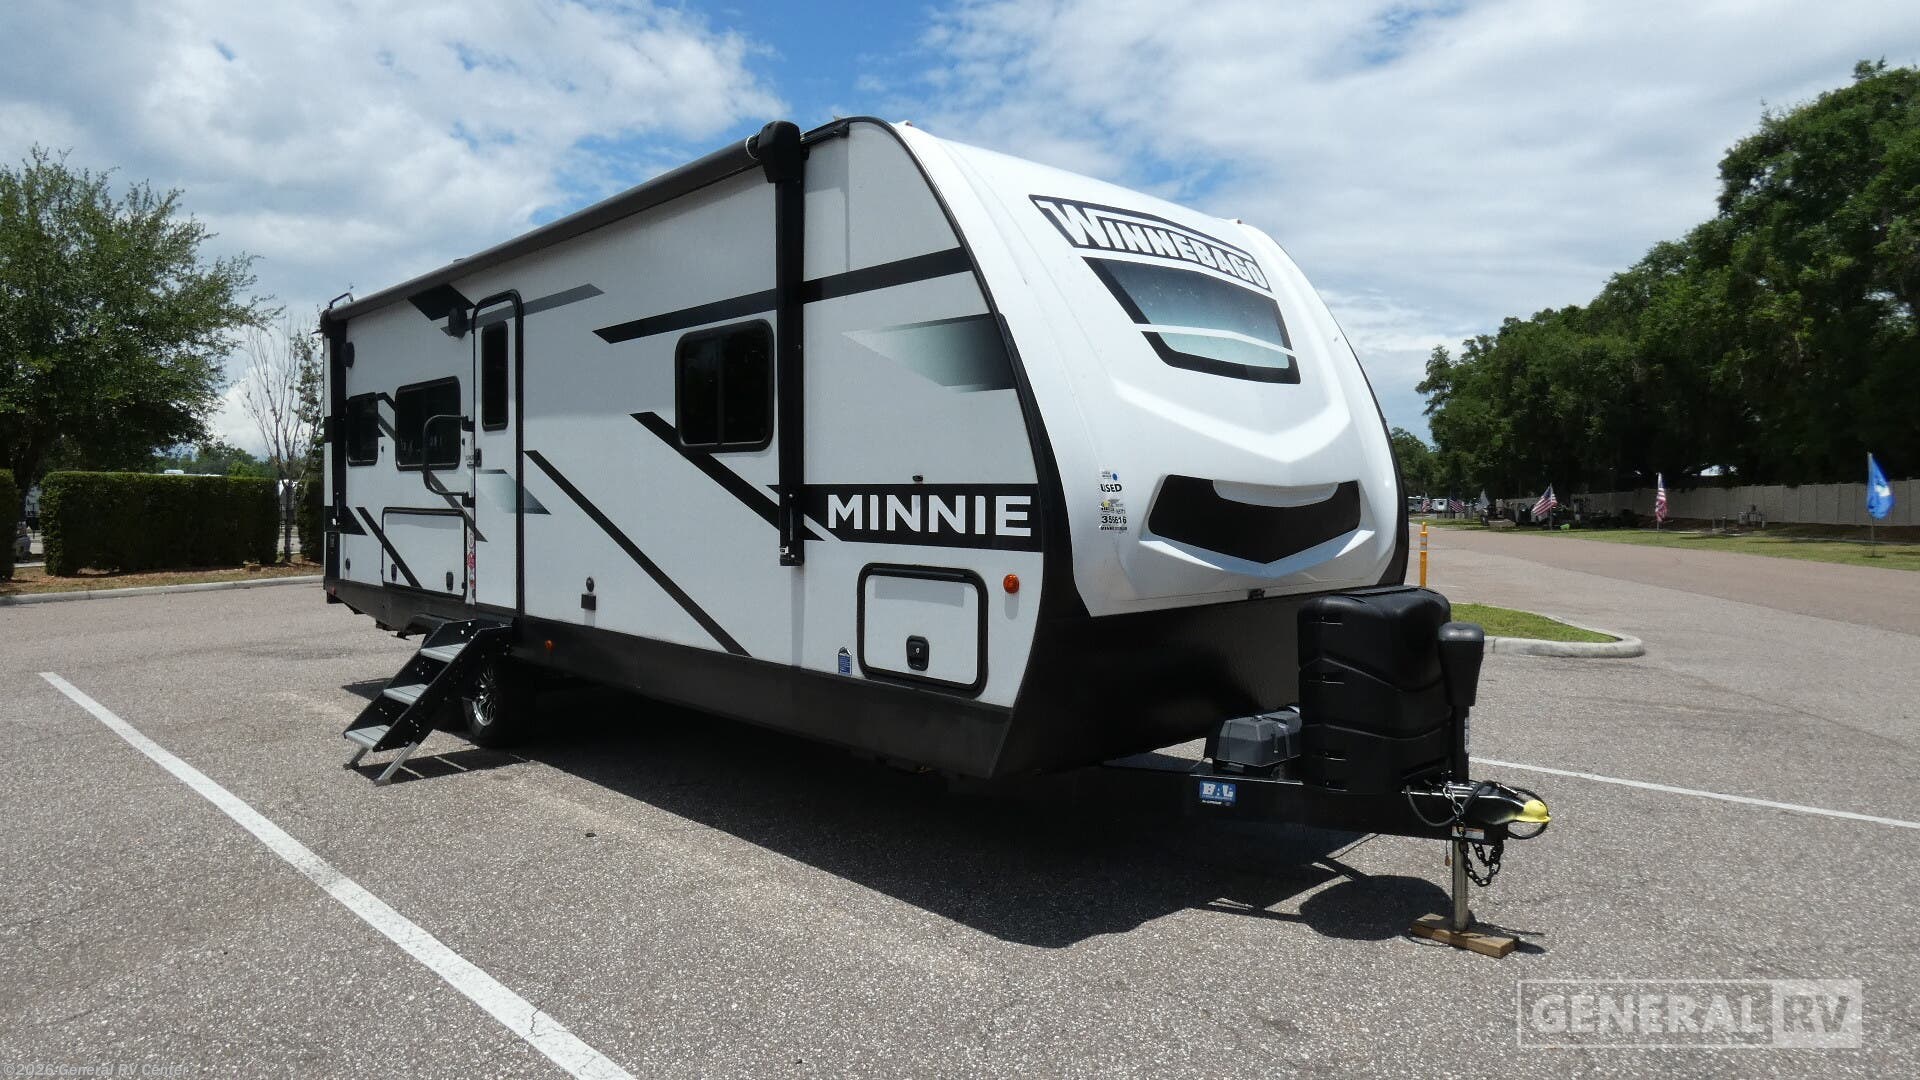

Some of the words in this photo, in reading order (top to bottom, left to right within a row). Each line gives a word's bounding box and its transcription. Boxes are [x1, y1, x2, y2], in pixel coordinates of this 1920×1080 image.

[1032, 198, 1270, 290] WINNEBAGO
[1100, 483, 1122, 493] USED
[827, 494, 1031, 537] MINNIE
